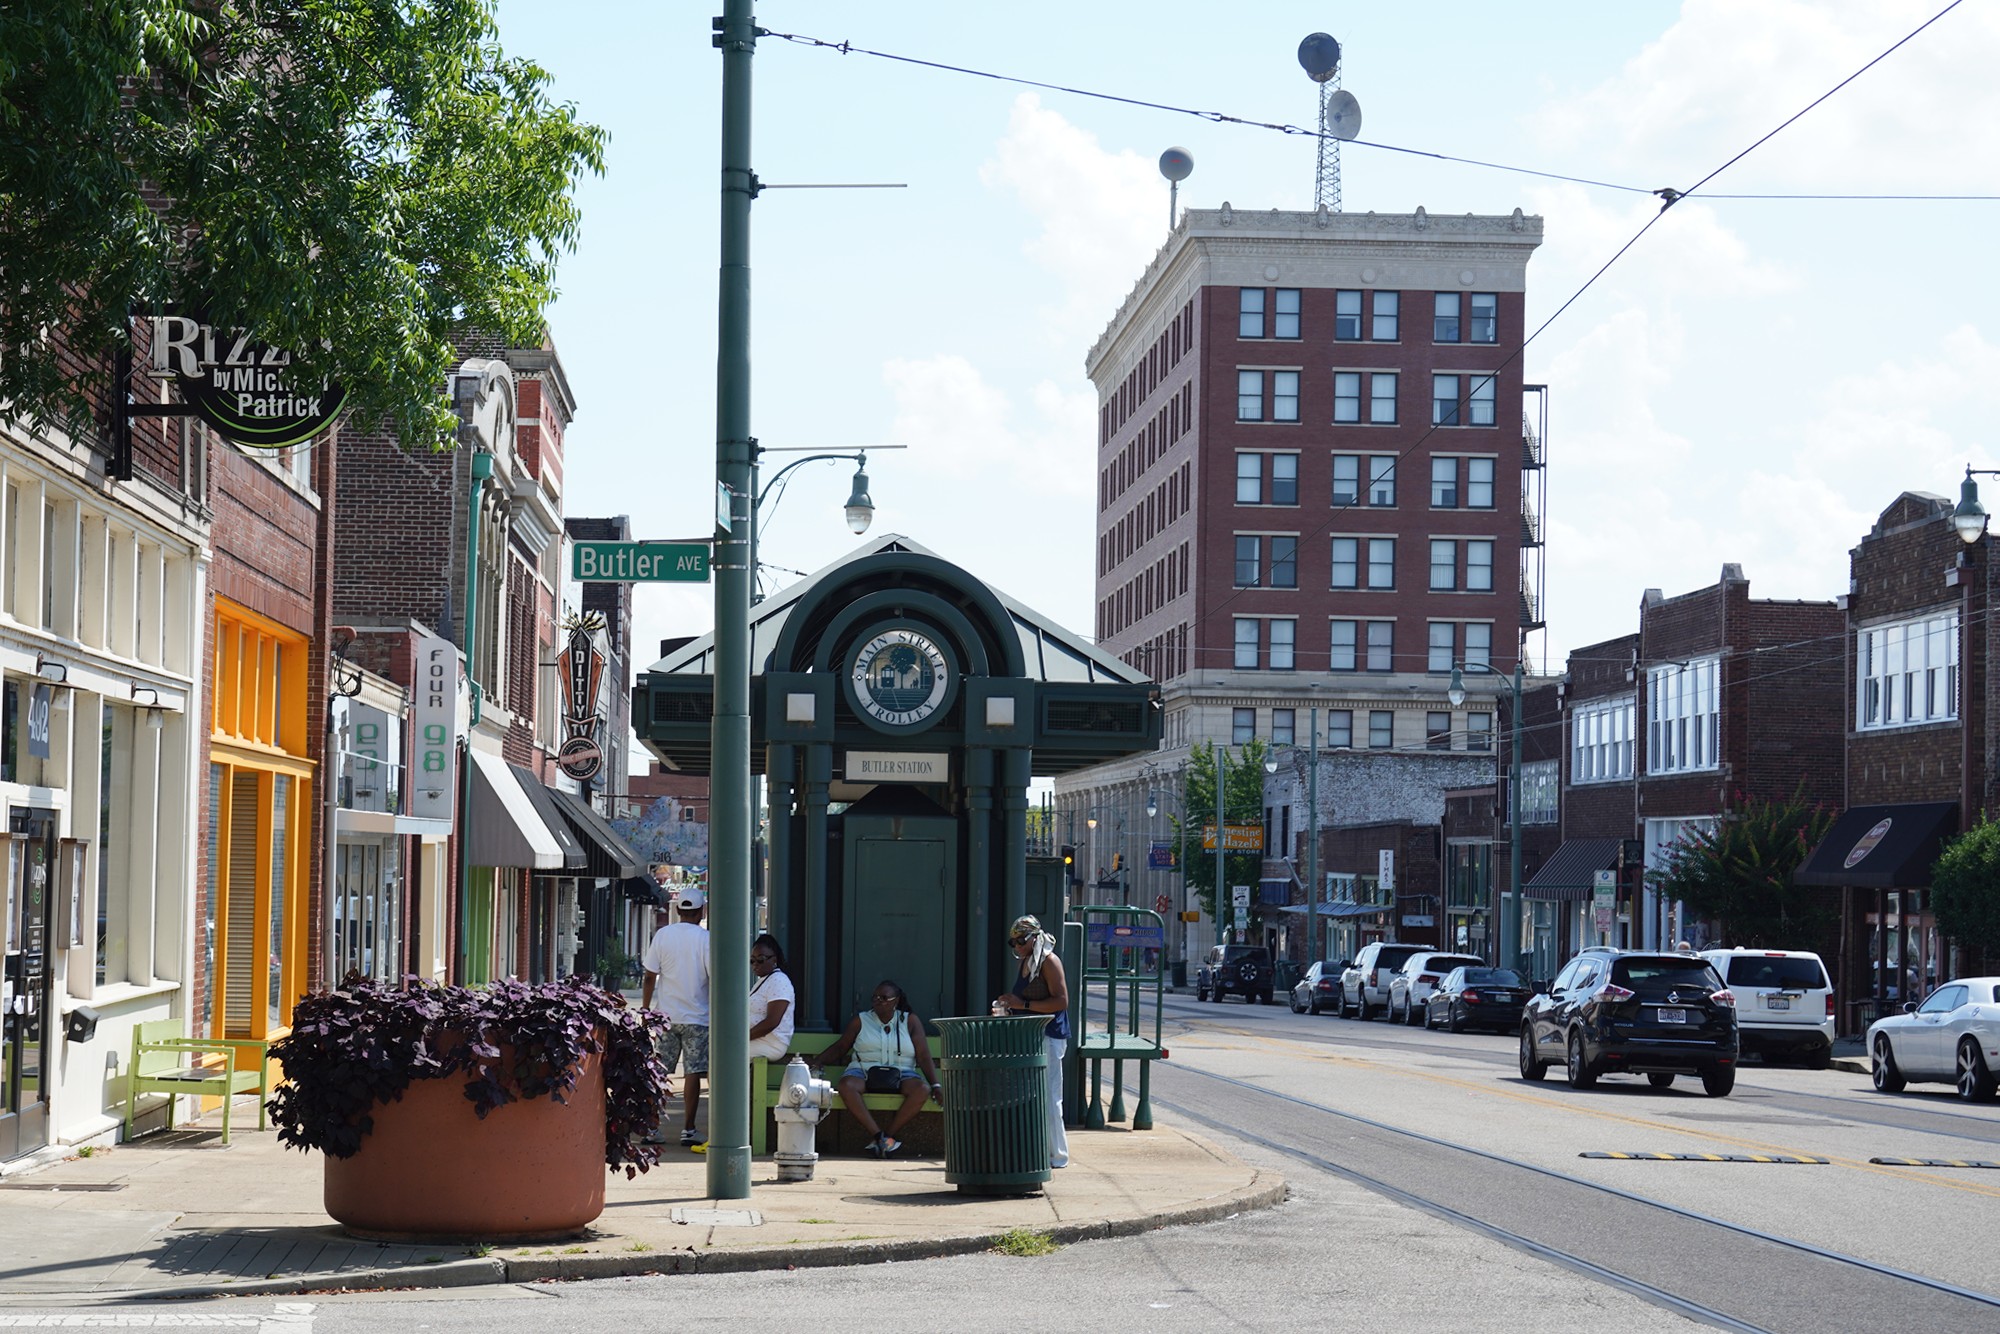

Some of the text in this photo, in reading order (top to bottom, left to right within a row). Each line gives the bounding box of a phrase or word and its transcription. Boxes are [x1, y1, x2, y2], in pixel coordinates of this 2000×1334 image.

[213, 367, 329, 392] by Michl
[238, 393, 321, 417] Patrick
[580, 547, 702, 578] Butler AVE
[856, 632, 945, 671] MAIN STREET
[575, 651, 584, 719] DITTY
[28, 696, 48, 743] 492
[423, 649, 446, 773] FOUR 98
[866, 699, 934, 724] TROLLEY
[571, 724, 588, 736] TV
[862, 760, 933, 774] BUTLER STATION
[653, 851, 671, 862] 516
